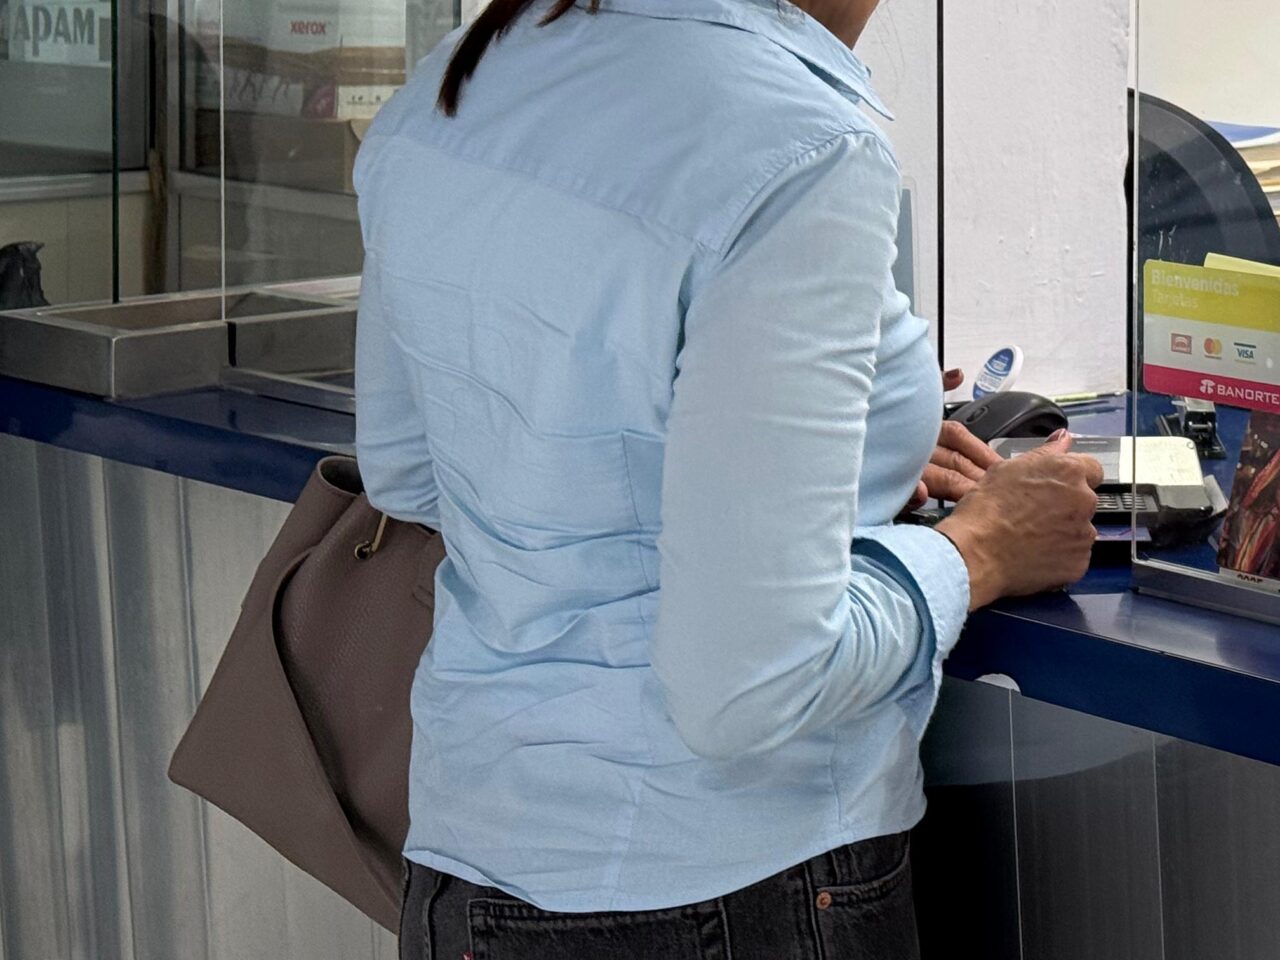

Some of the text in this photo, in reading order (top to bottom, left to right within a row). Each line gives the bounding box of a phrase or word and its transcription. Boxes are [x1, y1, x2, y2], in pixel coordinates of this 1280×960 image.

[289, 21, 327, 35] xerox
[1151, 268, 1239, 297] Bienvenidas
[1236, 348, 1255, 359] VISA
[1217, 384, 1280, 405] BANORTE
